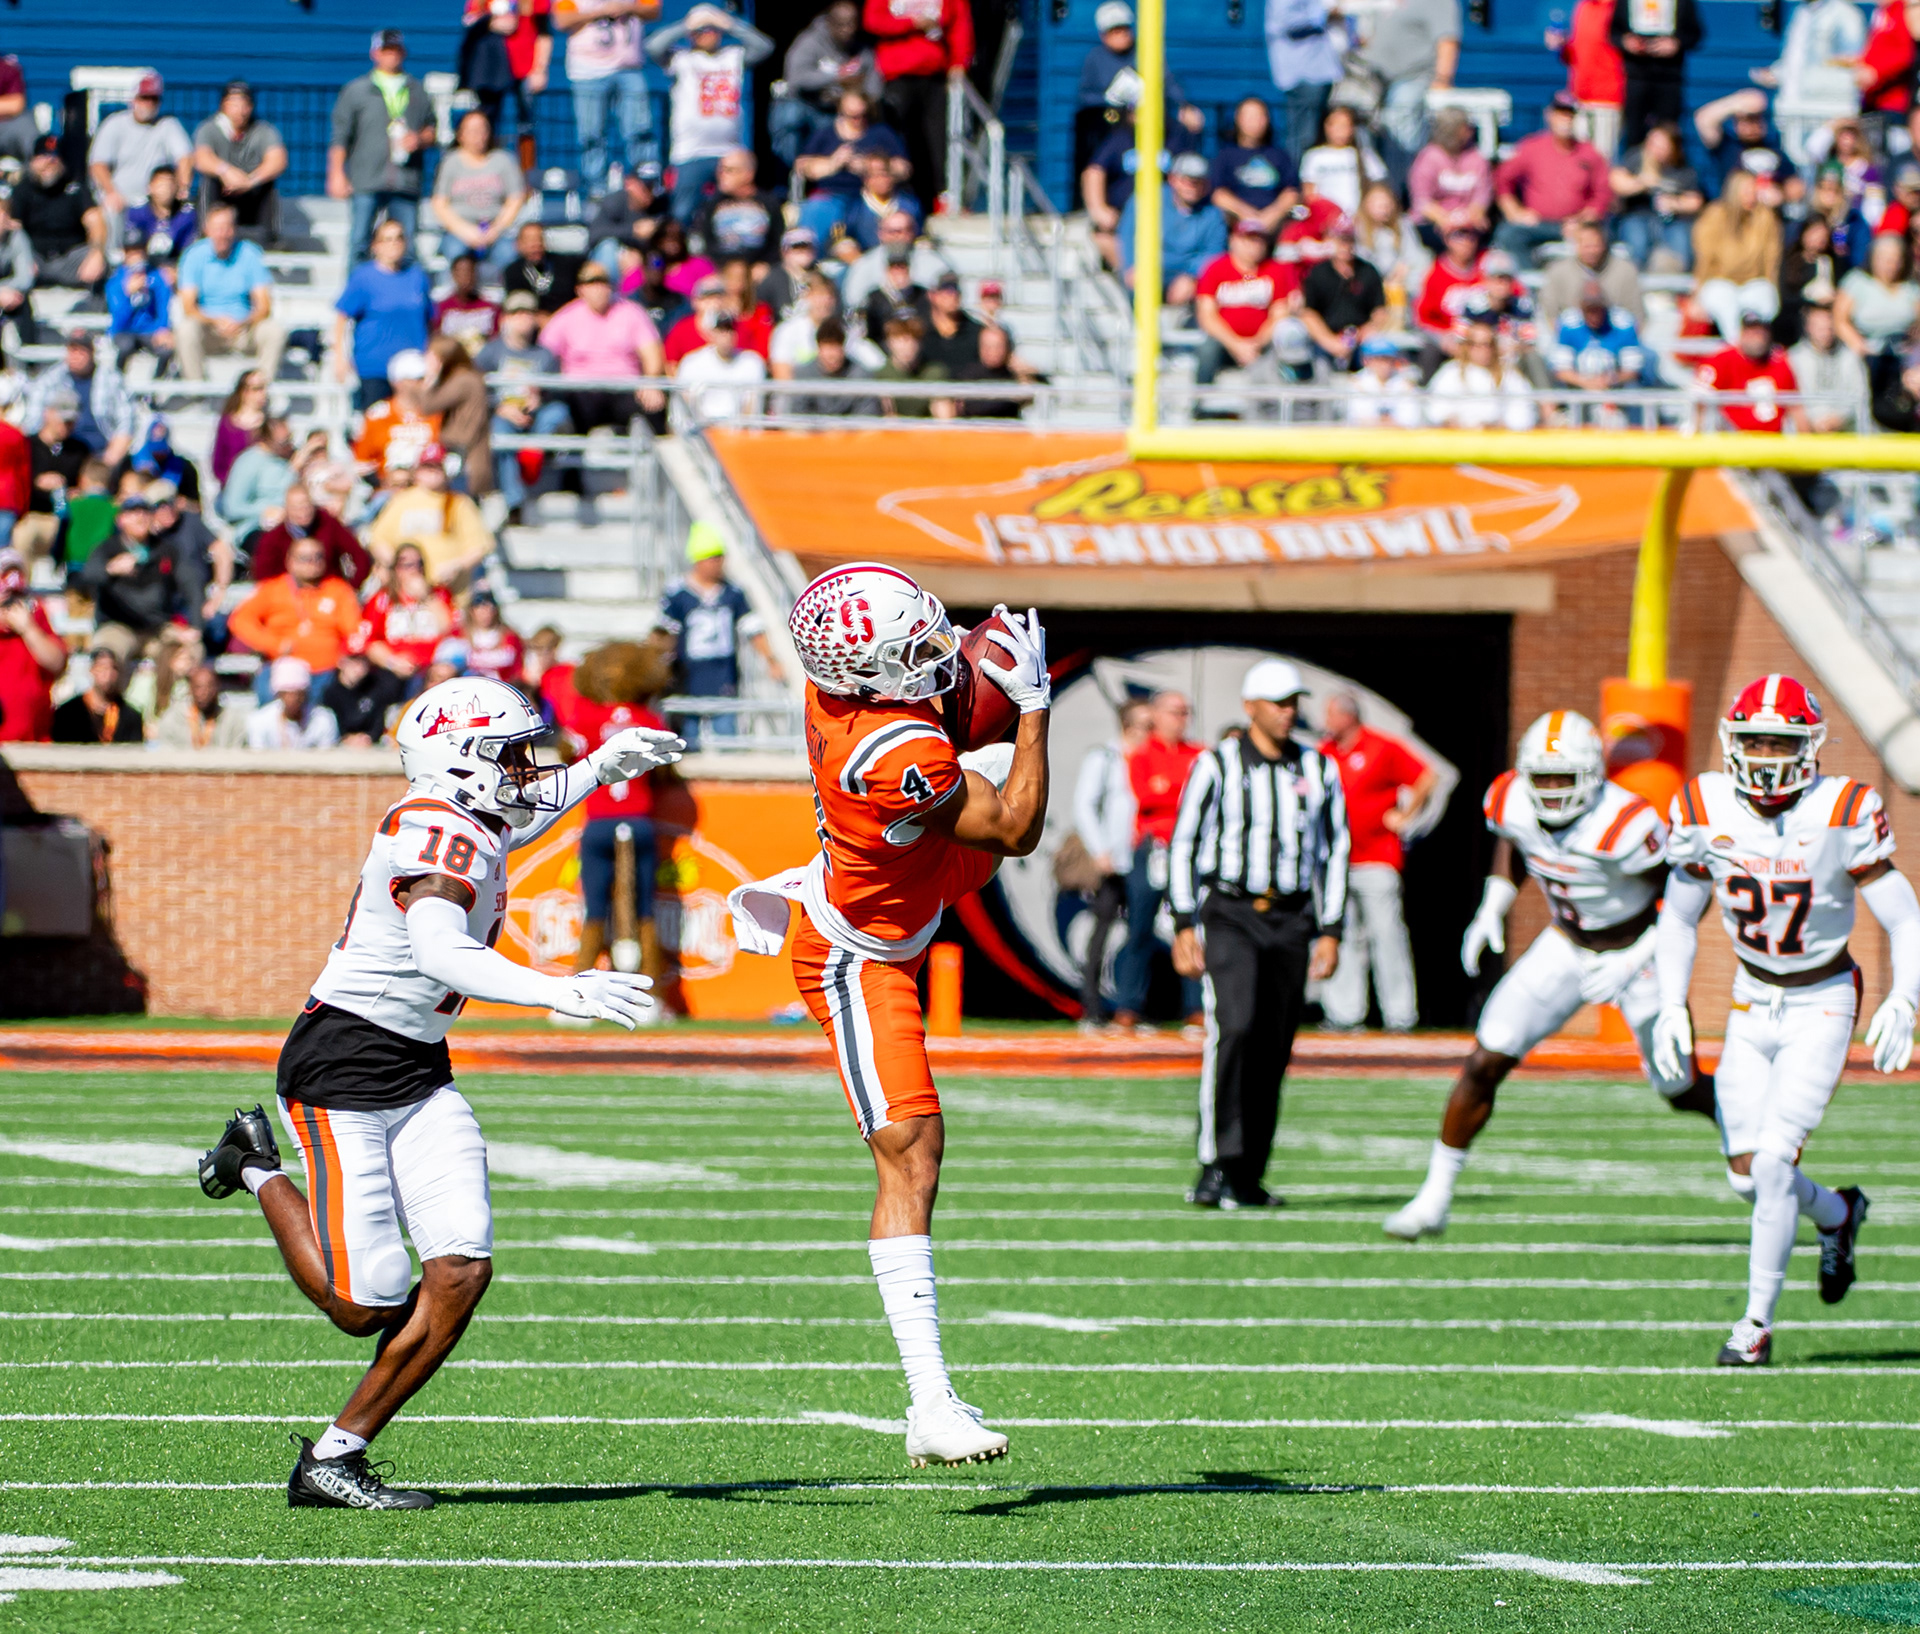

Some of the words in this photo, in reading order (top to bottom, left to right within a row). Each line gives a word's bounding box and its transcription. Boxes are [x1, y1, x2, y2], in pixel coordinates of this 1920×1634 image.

[1033, 466, 1390, 522] Reese's
[996, 514, 1268, 565] SENIOR
[1268, 507, 1484, 560] BOWL
[900, 763, 936, 804] 4
[418, 825, 478, 876] 18
[1726, 875, 1814, 956] 27
